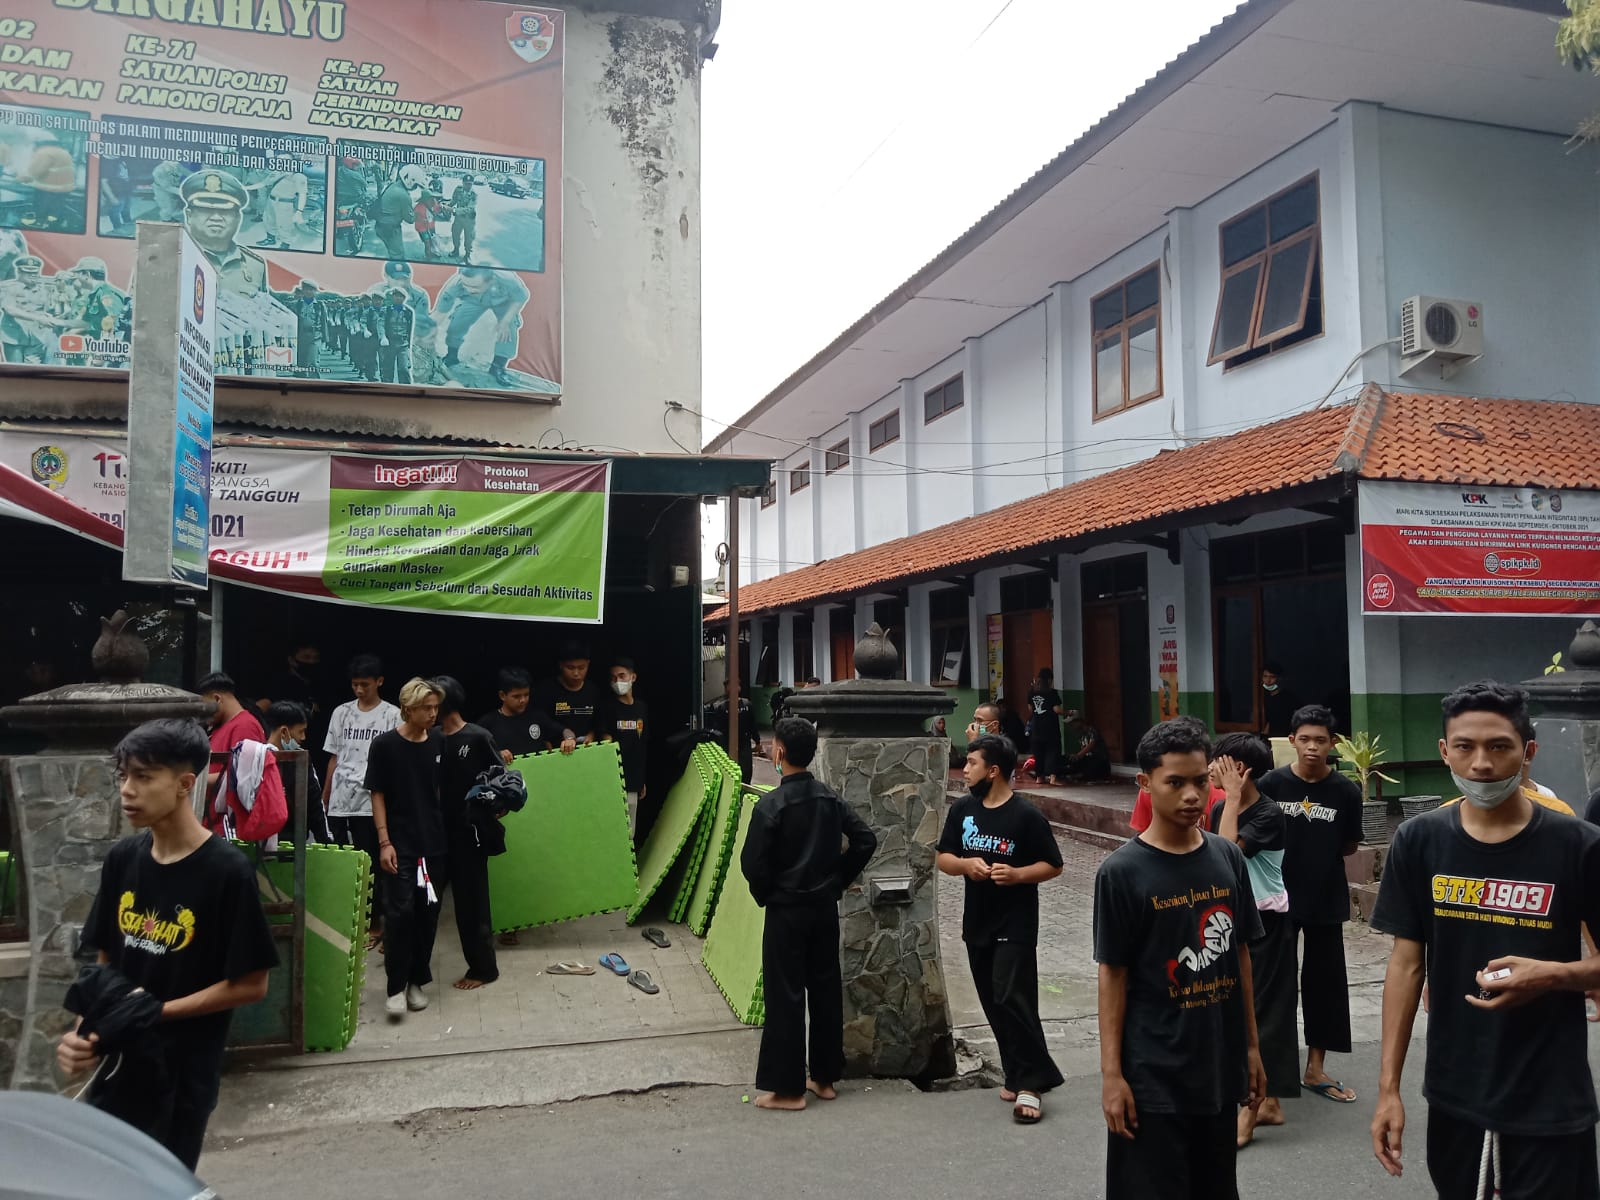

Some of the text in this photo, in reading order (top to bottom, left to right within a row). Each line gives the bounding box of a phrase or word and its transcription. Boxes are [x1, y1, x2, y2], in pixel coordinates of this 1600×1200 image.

[55, 0, 345, 42] GAHAYU
[1, 44, 72, 71] DAM
[120, 58, 287, 94] SATUAN POLISI
[319, 75, 398, 96] SATUAN
[117, 84, 292, 120] PAMONG PRAJA
[314, 92, 462, 121] PERLINDUNGAN
[309, 110, 440, 136] MASYARAKAT
[16, 111, 41, 128] DAN
[46, 114, 116, 135] SATLINMAS
[119, 123, 161, 139] DALAM
[164, 127, 238, 146] MENDUKUNG
[241, 136, 315, 154] PENCEGAHAN
[318, 141, 341, 156] DAN
[343, 145, 425, 165] PENGENDALIAN
[426, 154, 477, 171] PANDEMI
[479, 158, 528, 175] COVID-19
[85, 139, 137, 159] MENUJU
[140, 145, 202, 164] INDONESIA
[204, 151, 240, 168] MAJU
[242, 154, 266, 169] DAN
[84, 338, 129, 354] YouTube
[484, 465, 529, 478] Protokol
[93, 482, 125, 490] KEBANG
[484, 478, 539, 492] Kesehatan
[220, 489, 300, 503] TANGGUH
[1461, 493, 1488, 504] KPK
[348, 504, 456, 519] Tetap Dirumah Aja
[209, 514, 244, 537] 021
[347, 525, 375, 540] Jaga
[378, 524, 442, 537] Kesehatan
[345, 545, 389, 556] Hindari
[459, 543, 480, 555] dan
[483, 544, 508, 558] Jaga
[342, 562, 444, 575] Gunakan Masker
[1501, 558, 1539, 570] spikpk.id
[339, 578, 593, 601] Cuci Tangan Sebelum dan Sesudah Aktivitas
[1425, 577, 1452, 585] JANGAN
[1453, 578, 1471, 586] LUPA
[1482, 578, 1514, 587] KUISONER
[1309, 805, 1337, 822] ROCK
[1432, 875, 1545, 910] STK 1903
